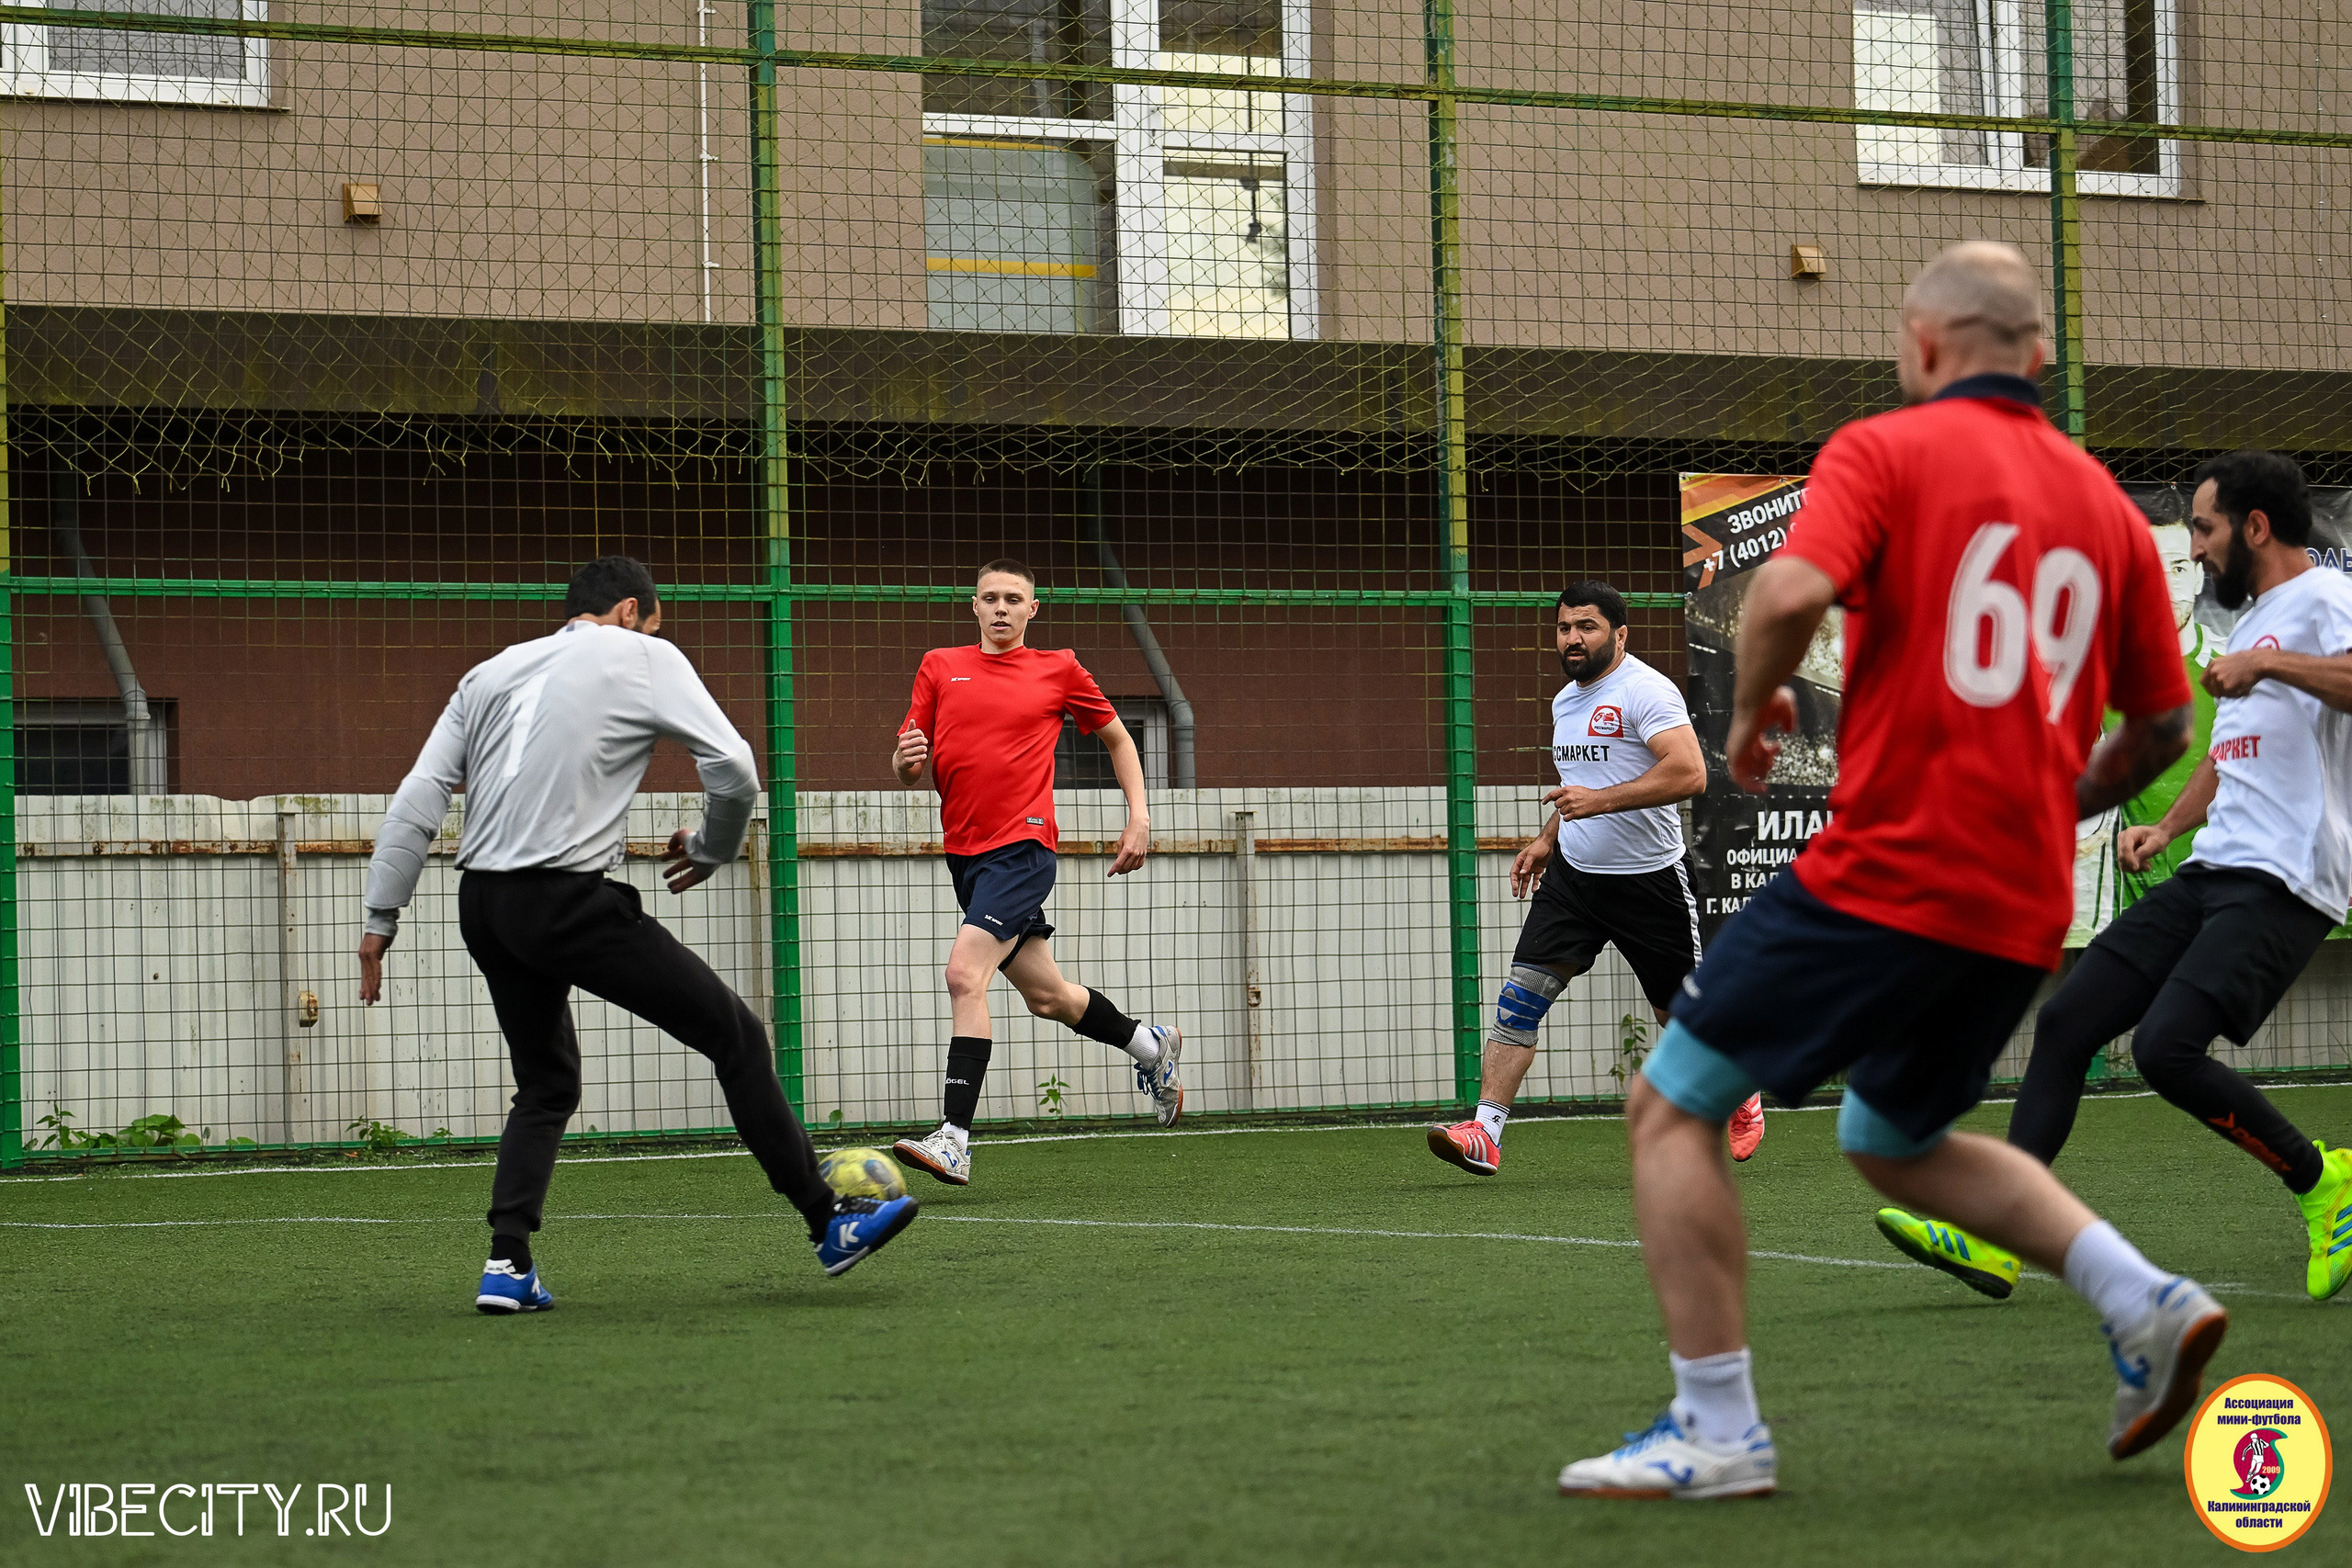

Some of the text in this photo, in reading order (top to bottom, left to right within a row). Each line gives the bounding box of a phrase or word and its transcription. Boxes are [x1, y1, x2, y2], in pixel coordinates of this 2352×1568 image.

[1703, 526, 1788, 572] +7 (4012)
[1943, 520, 2103, 726] 69
[503, 672, 549, 779] 1
[1731, 874, 1742, 889] В
[1706, 898, 1718, 914] Г.
